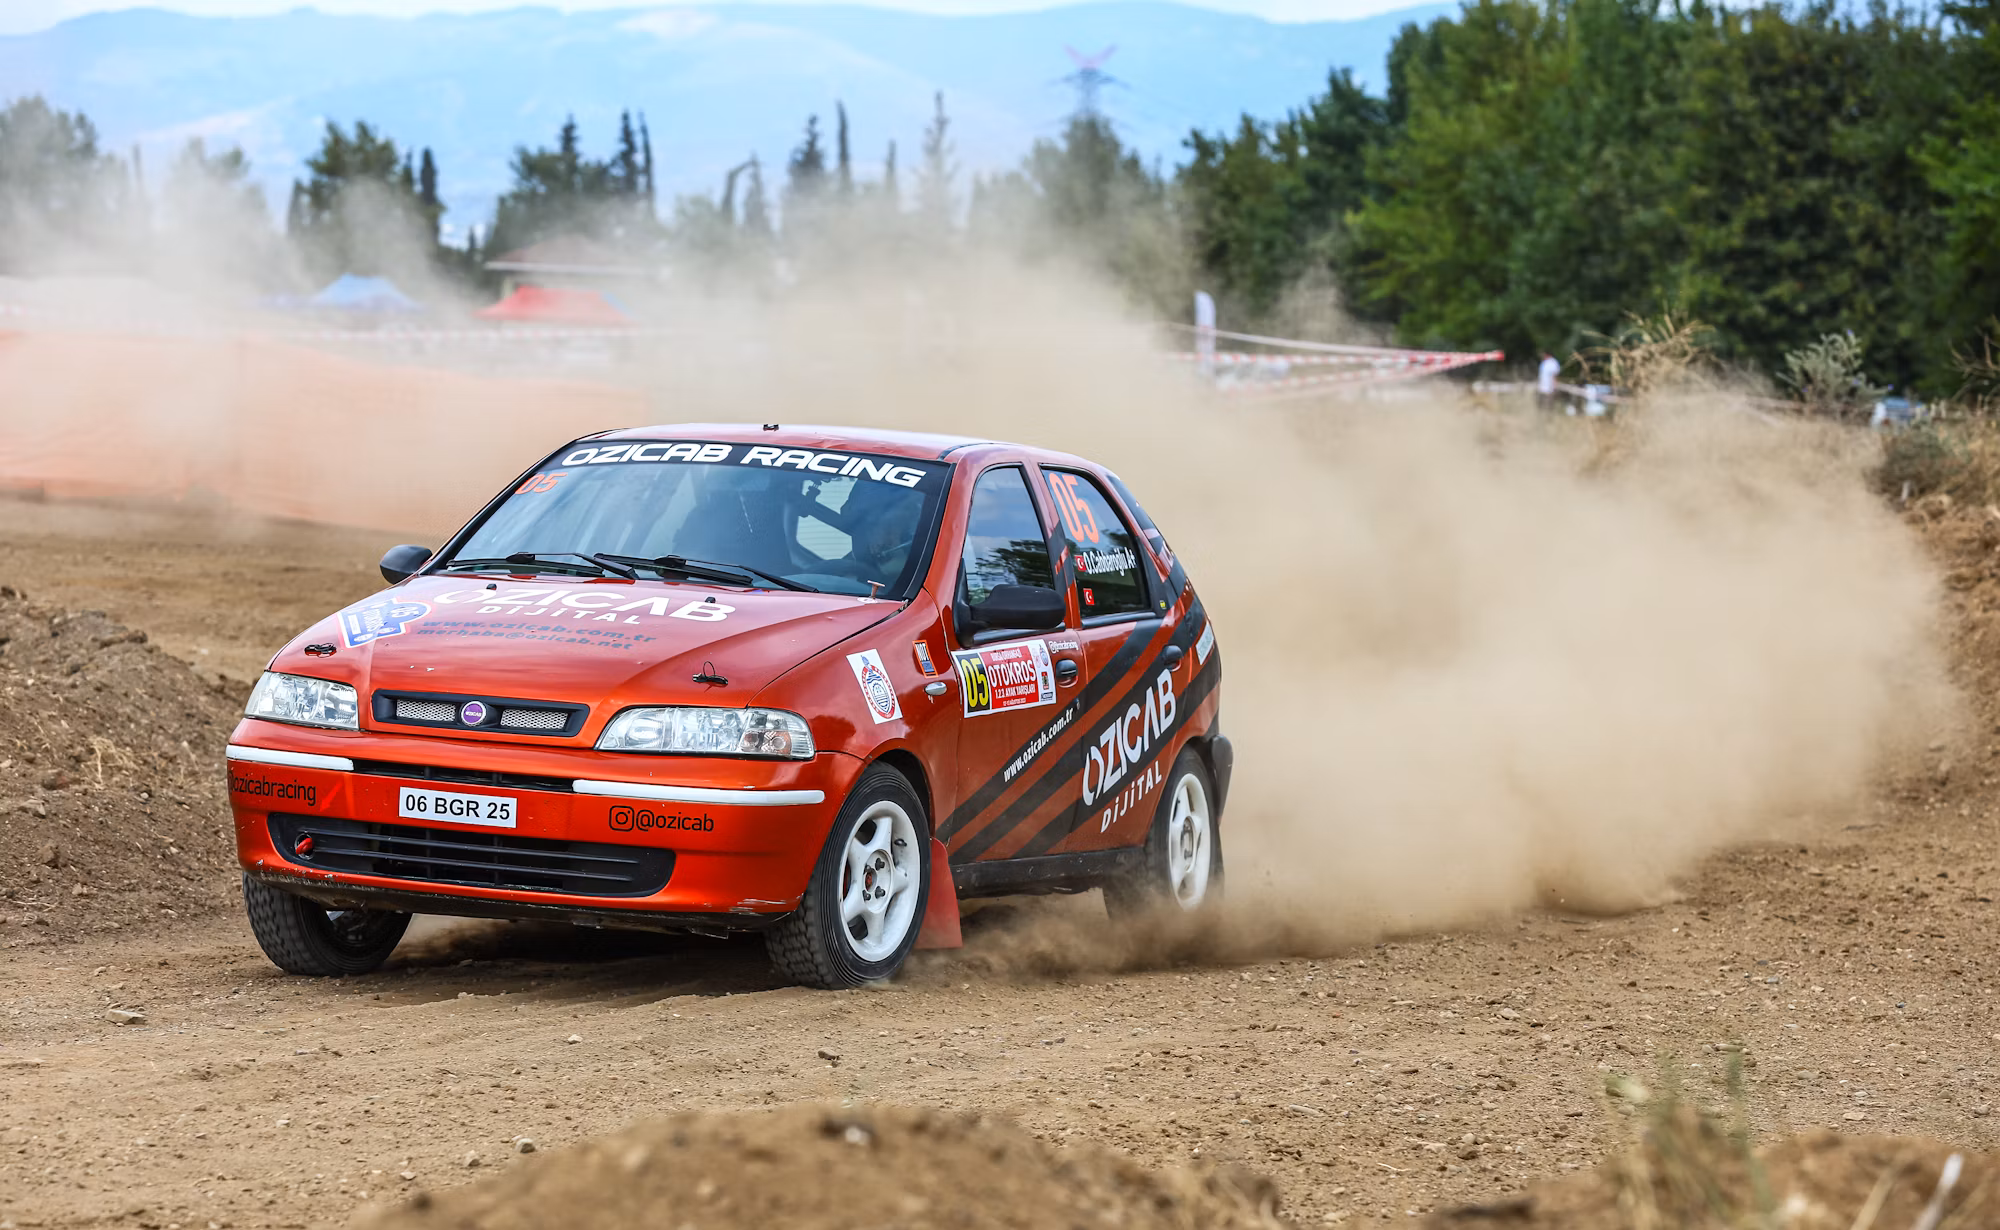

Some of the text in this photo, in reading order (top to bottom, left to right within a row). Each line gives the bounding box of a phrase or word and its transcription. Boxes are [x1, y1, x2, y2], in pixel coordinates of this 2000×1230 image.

[561, 442, 928, 489] OZICAB RACING
[514, 472, 568, 495] 05
[1048, 472, 1100, 545] 05
[433, 588, 736, 622] OZICAB
[417, 629, 633, 649] merhaba@ozicab.net
[422, 621, 657, 642] www.ozicab.com.tr
[961, 658, 989, 707] 05
[988, 660, 1036, 687] OTOKROS
[1003, 707, 1074, 783] www.ozicab.com.tr
[1082, 668, 1177, 806] OZICAB
[405, 794, 510, 820] 06 BGR 25
[636, 809, 715, 832] @ozicab
